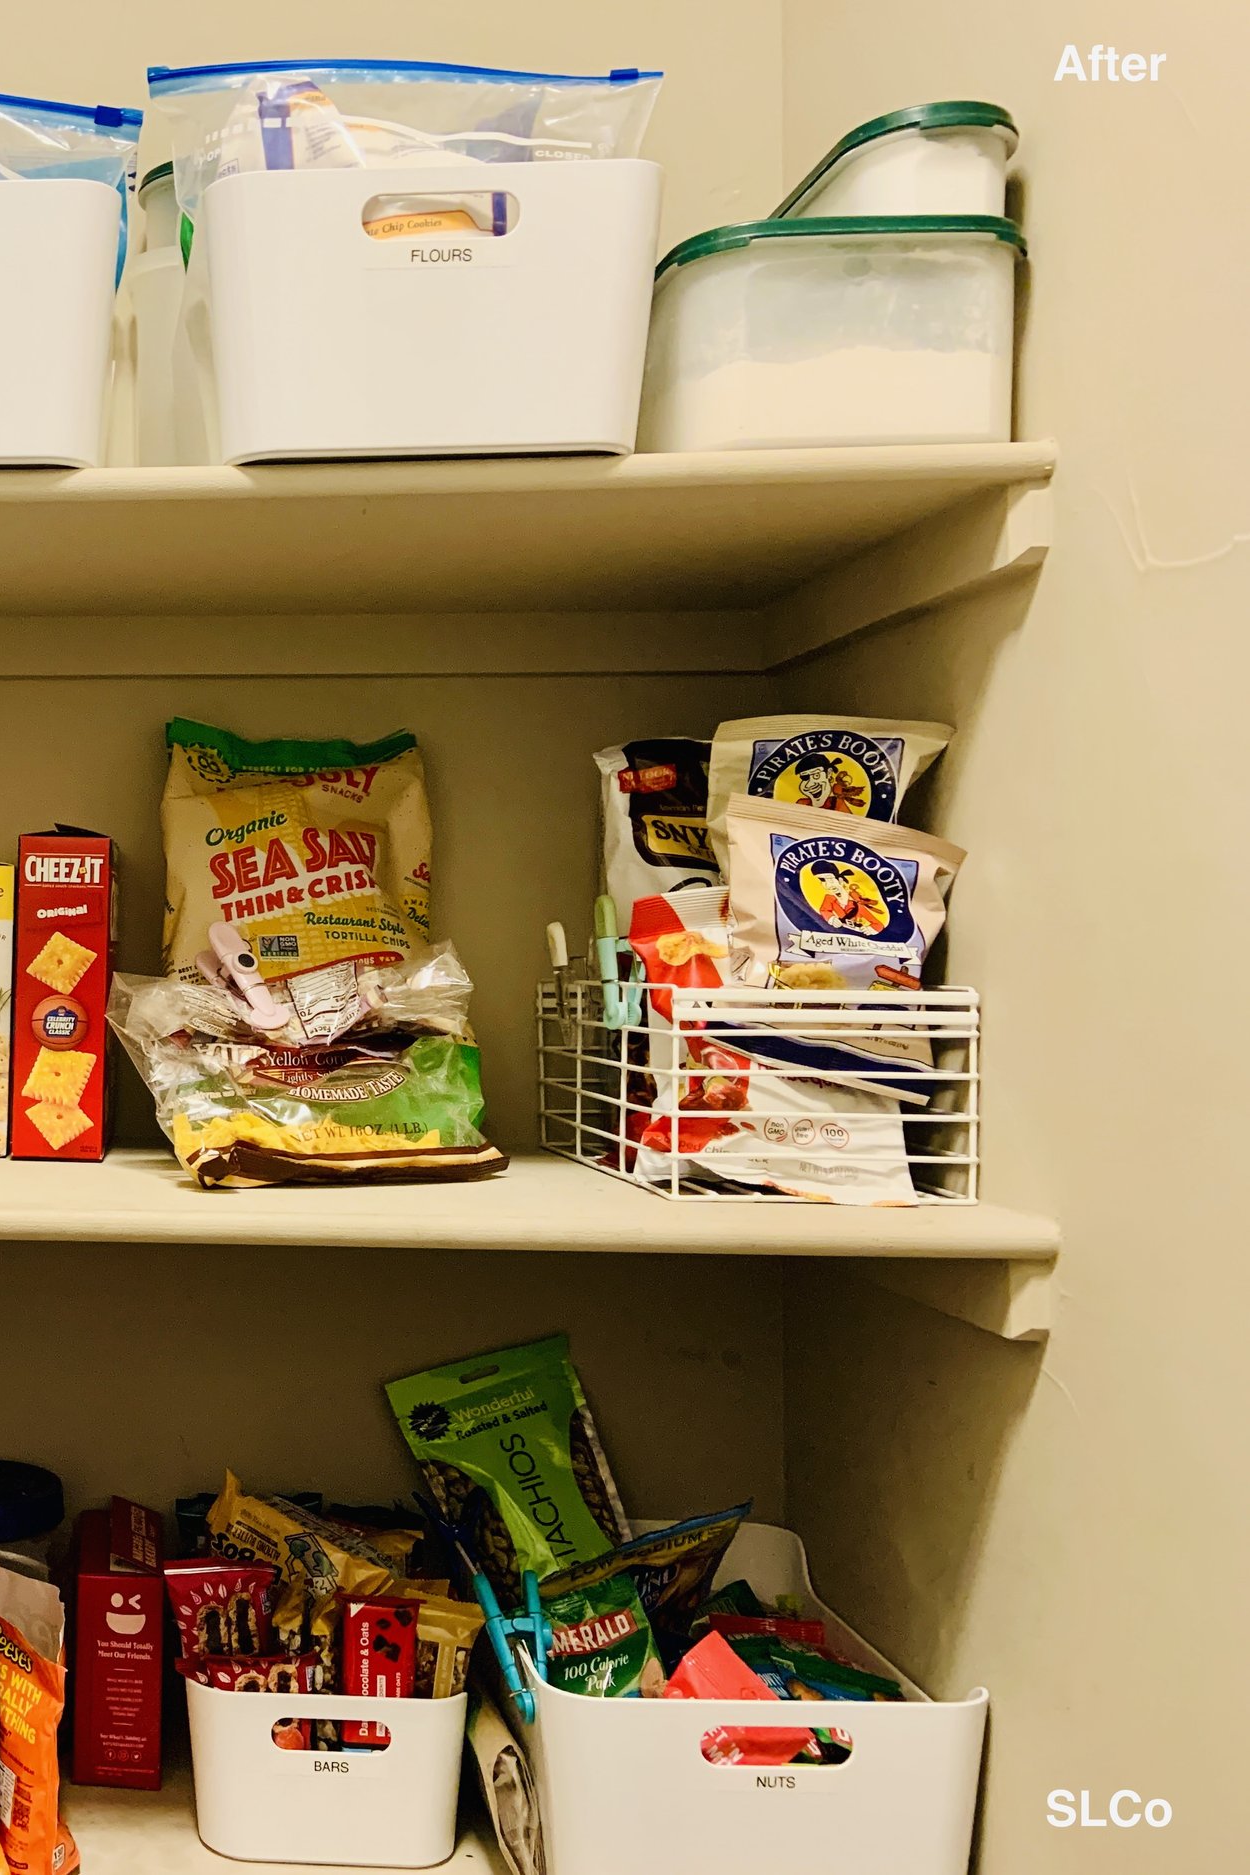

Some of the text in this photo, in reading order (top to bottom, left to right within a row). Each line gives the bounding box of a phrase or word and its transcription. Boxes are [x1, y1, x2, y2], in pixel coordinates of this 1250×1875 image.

[382, 217, 442, 233] Chip Cookies
[411, 248, 472, 263] FLOURS
[285, 765, 304, 773] FOR
[761, 733, 892, 788] PIRATE'S BOOTY
[321, 784, 364, 804] SNACKS
[205, 810, 288, 847] Organic
[651, 819, 710, 850] SNY
[209, 826, 377, 900] SEA SALT
[779, 840, 905, 911] PIRATE'S BOOTY
[221, 889, 283, 923] THIN
[287, 886, 305, 905] &
[304, 911, 407, 936] Restaurant Style
[279, 936, 297, 944] NON
[325, 930, 411, 950] TORTILLA CHIPS
[805, 933, 830, 949] Aged
[836, 937, 866, 949] White
[46, 1022, 75, 1031] CRUNCH
[280, 1070, 313, 1084] Lightly
[287, 1069, 406, 1101] HOMEMADE TASTE
[768, 1126, 785, 1136] GMO
[825, 1128, 844, 1137] 100
[452, 1385, 535, 1422] Wonderful
[455, 1400, 548, 1441] Roasted & Salted
[500, 1432, 578, 1560] TACHIOS
[551, 1612, 631, 1654] MERALD
[97, 1639, 153, 1651] You Should Totally
[97, 1650, 126, 1659] Meet Our
[358, 1621, 370, 1696] ocolate Oats
[563, 1655, 630, 1681] 100 Calorie
[10, 1670, 43, 1706] WITH
[586, 1674, 616, 1693] Pack
[0, 1704, 37, 1745] YTHING
[313, 1761, 349, 1773] BARS
[756, 1776, 796, 1789] NUTS
